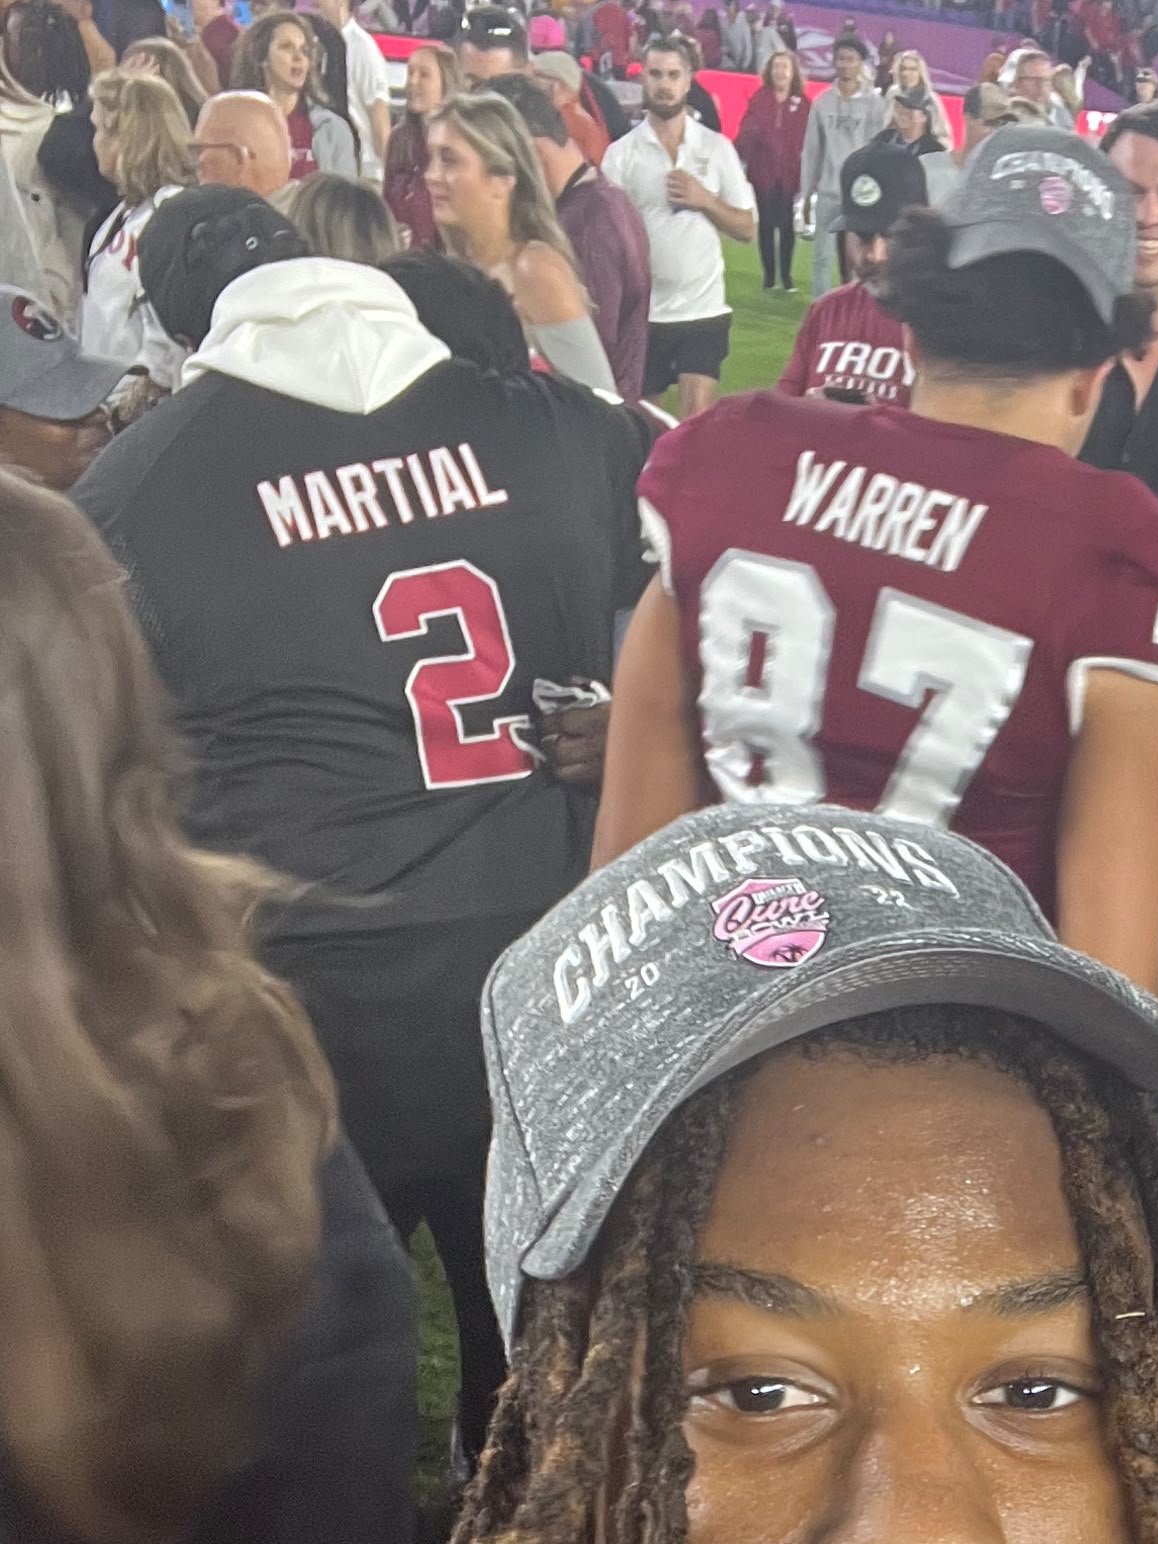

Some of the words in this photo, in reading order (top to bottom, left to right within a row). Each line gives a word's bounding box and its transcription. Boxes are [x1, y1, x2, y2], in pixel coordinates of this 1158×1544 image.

[257, 442, 508, 547] MARTIAL
[783, 450, 988, 572] WARREN
[373, 559, 534, 790] 2
[699, 547, 1034, 828] 87
[552, 824, 961, 1025] CHAMPIONS
[713, 890, 826, 942] Cure
[624, 963, 661, 999] 20
